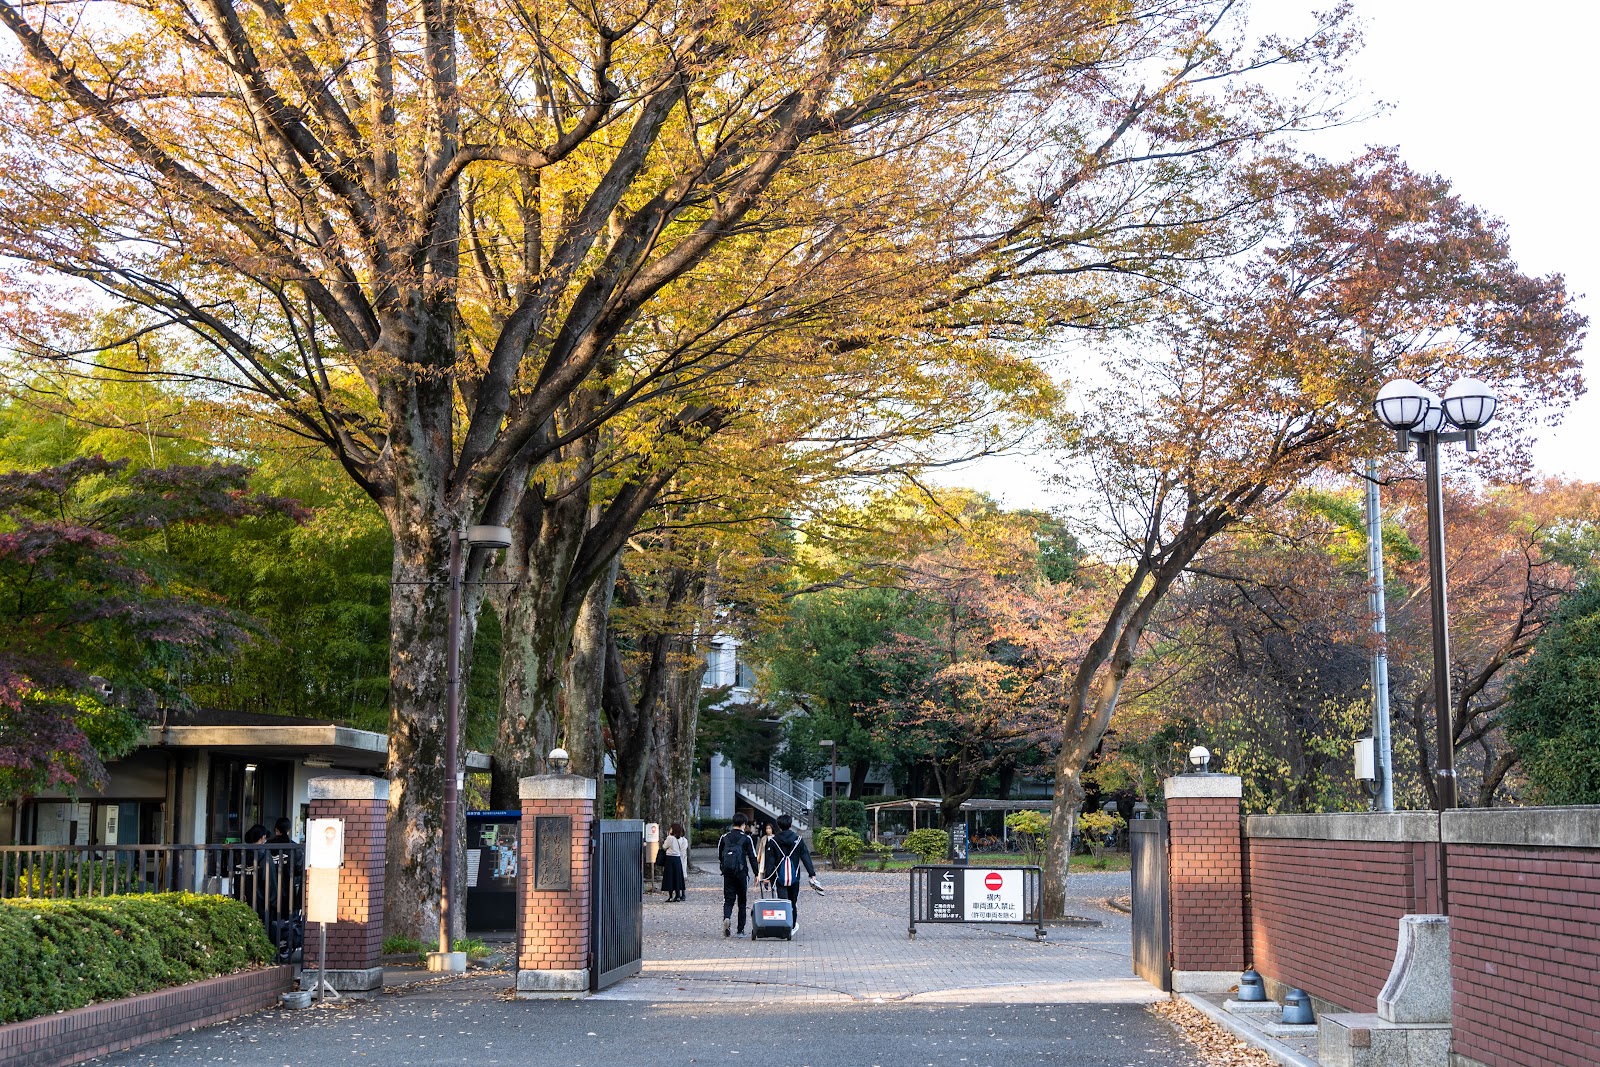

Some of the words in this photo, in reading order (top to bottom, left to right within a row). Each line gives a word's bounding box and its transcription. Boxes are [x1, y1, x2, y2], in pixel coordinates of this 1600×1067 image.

[986, 893, 1002, 901] 構内
[972, 902, 1016, 910] 車両進入禁止
